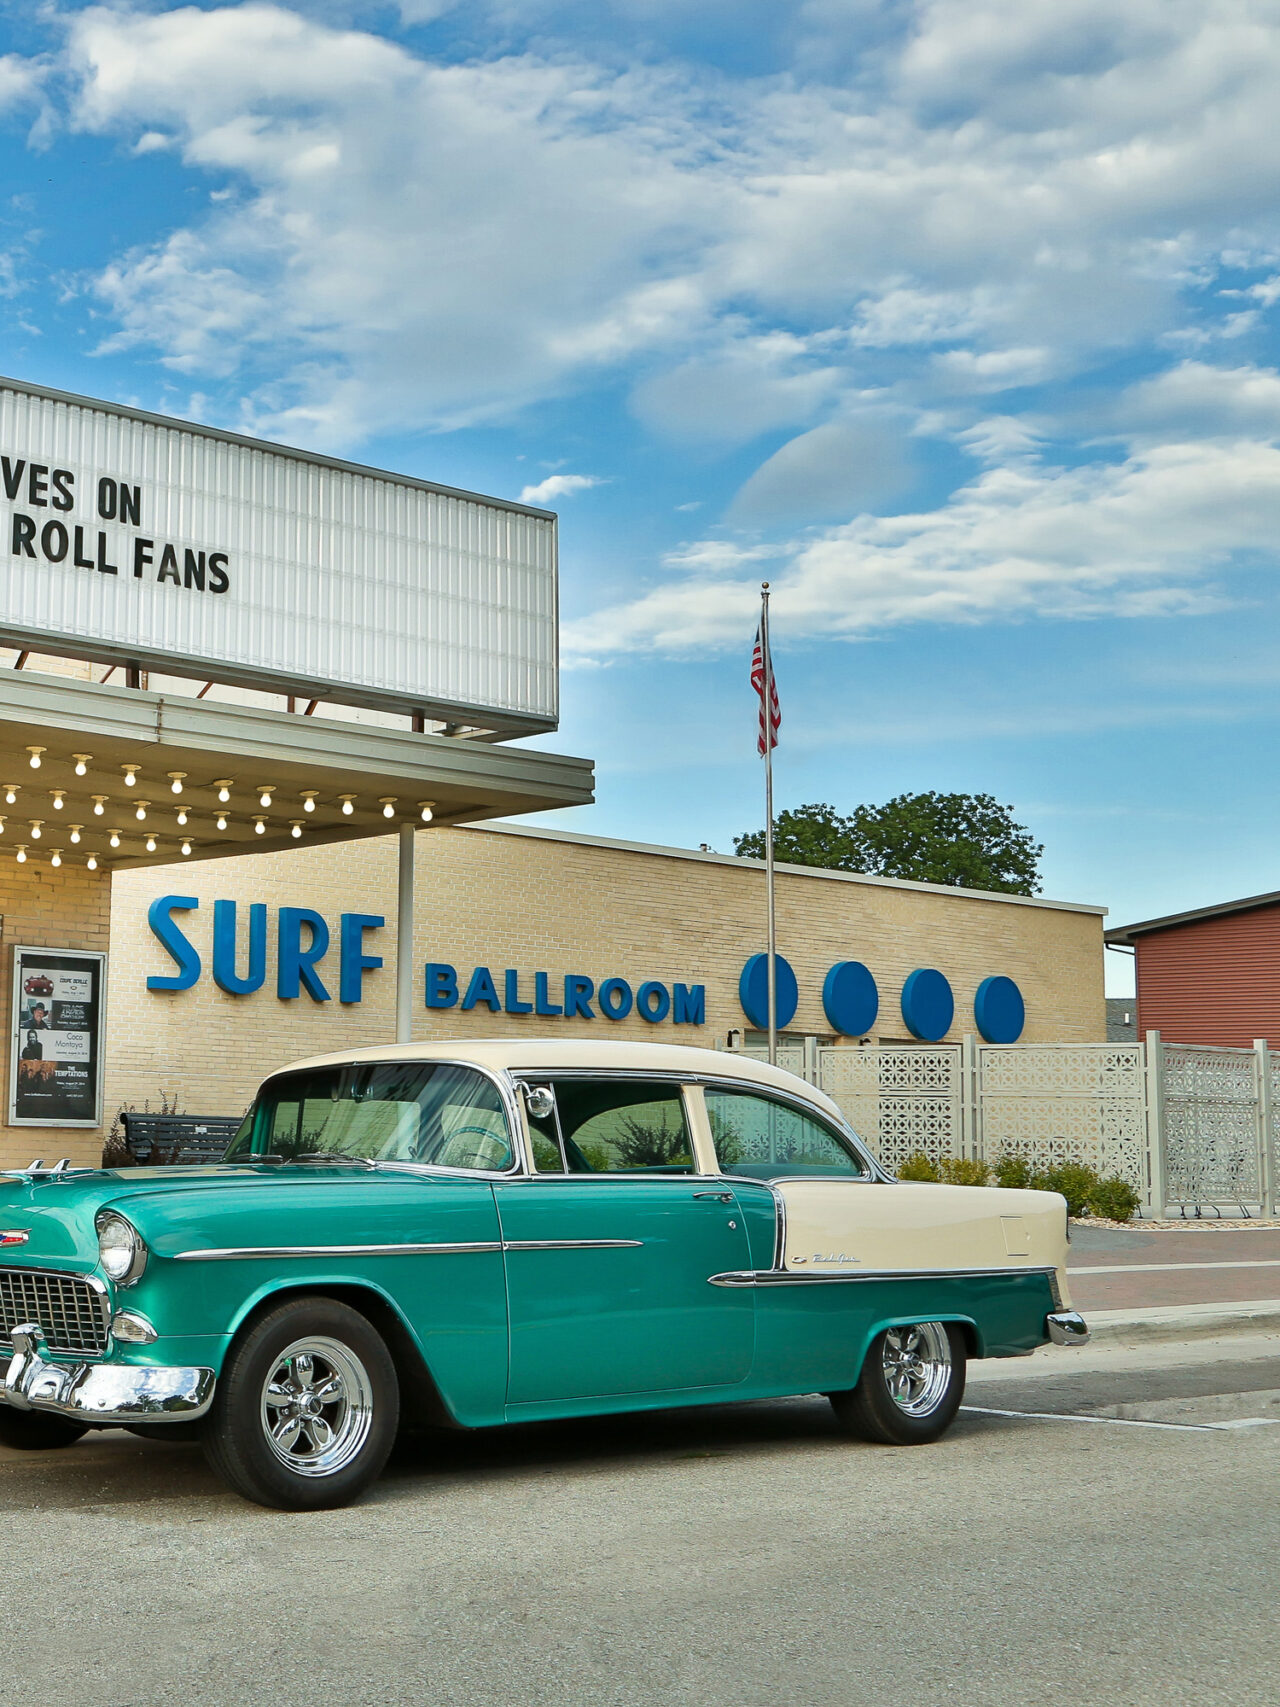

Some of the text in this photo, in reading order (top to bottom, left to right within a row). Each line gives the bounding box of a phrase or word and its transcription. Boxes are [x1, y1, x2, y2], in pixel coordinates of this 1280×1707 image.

[98, 477, 141, 526] ON
[12, 513, 118, 575] ROLL
[134, 538, 230, 594] FANS
[146, 894, 385, 1004] SURF
[425, 962, 706, 1025] BALLROOM
[55, 1041, 83, 1049] Montoya
